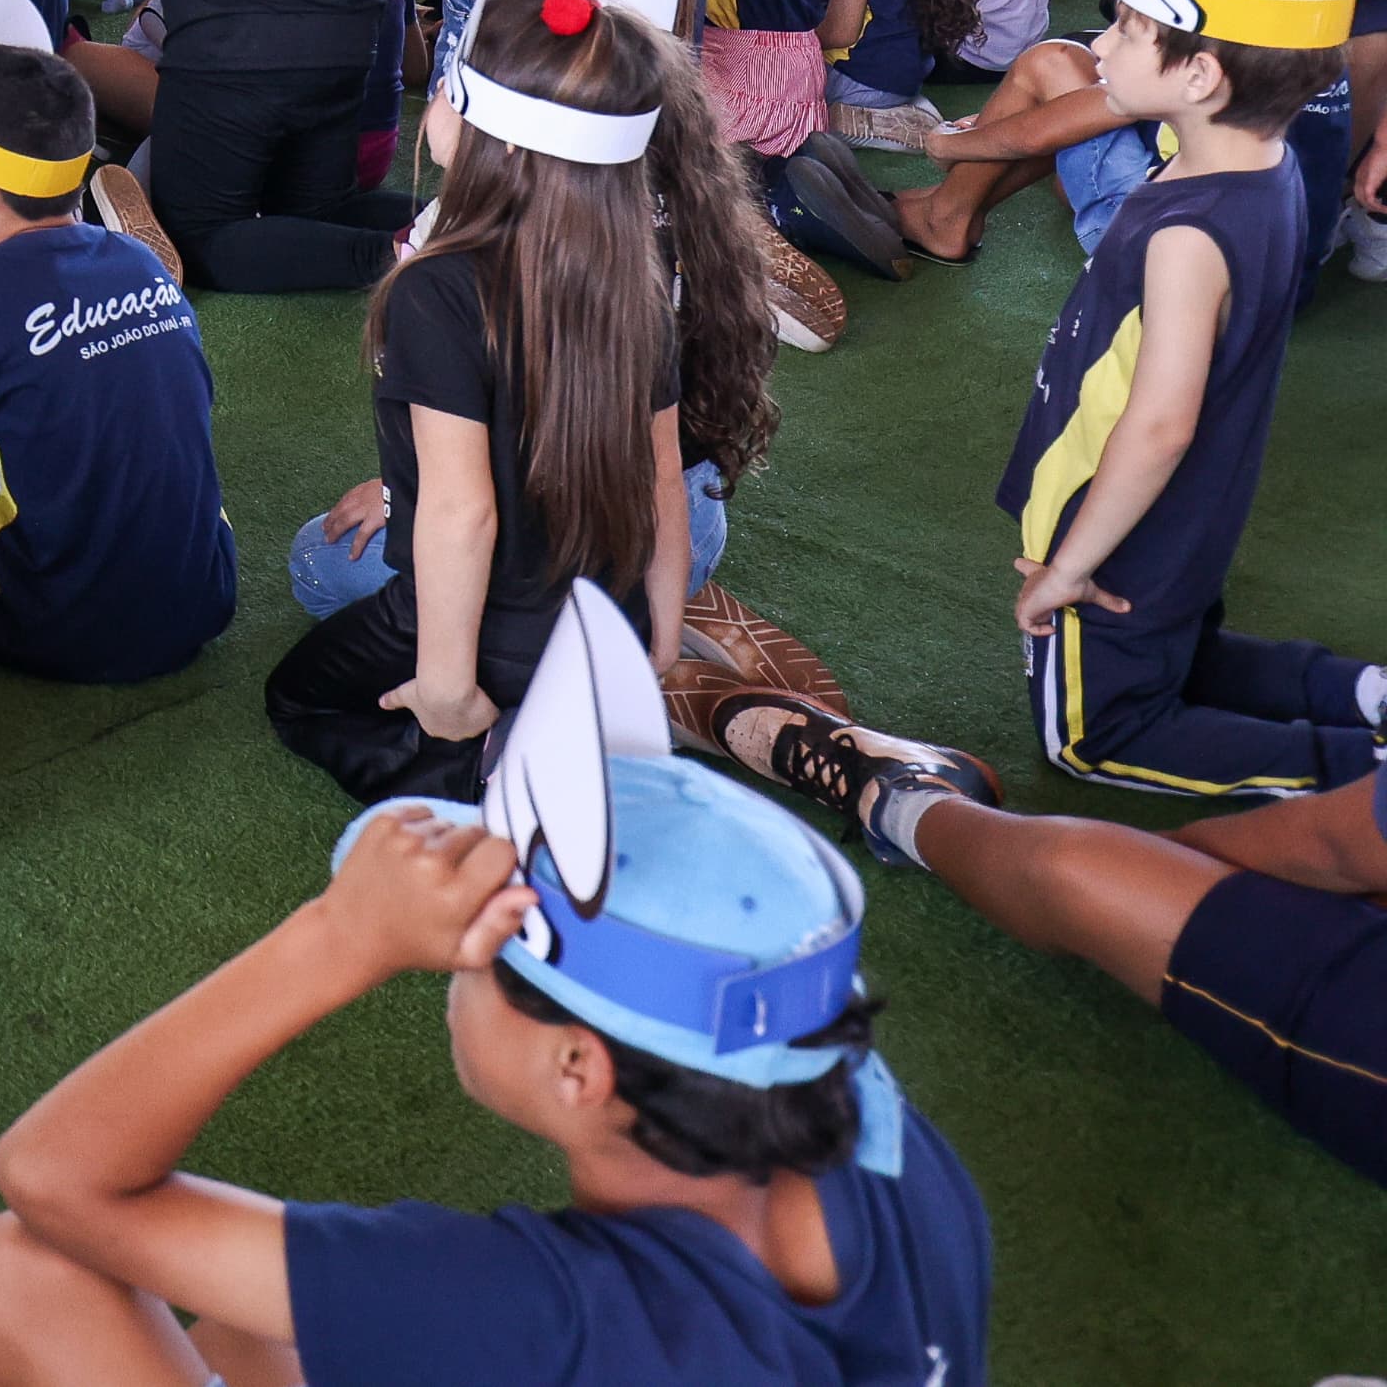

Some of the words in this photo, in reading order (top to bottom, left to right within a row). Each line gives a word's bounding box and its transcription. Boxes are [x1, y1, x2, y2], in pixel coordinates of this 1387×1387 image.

[25, 276, 182, 357] Educação
[80, 341, 109, 360] SÃO
[111, 329, 142, 350] JOÃO
[142, 324, 159, 337] DO
